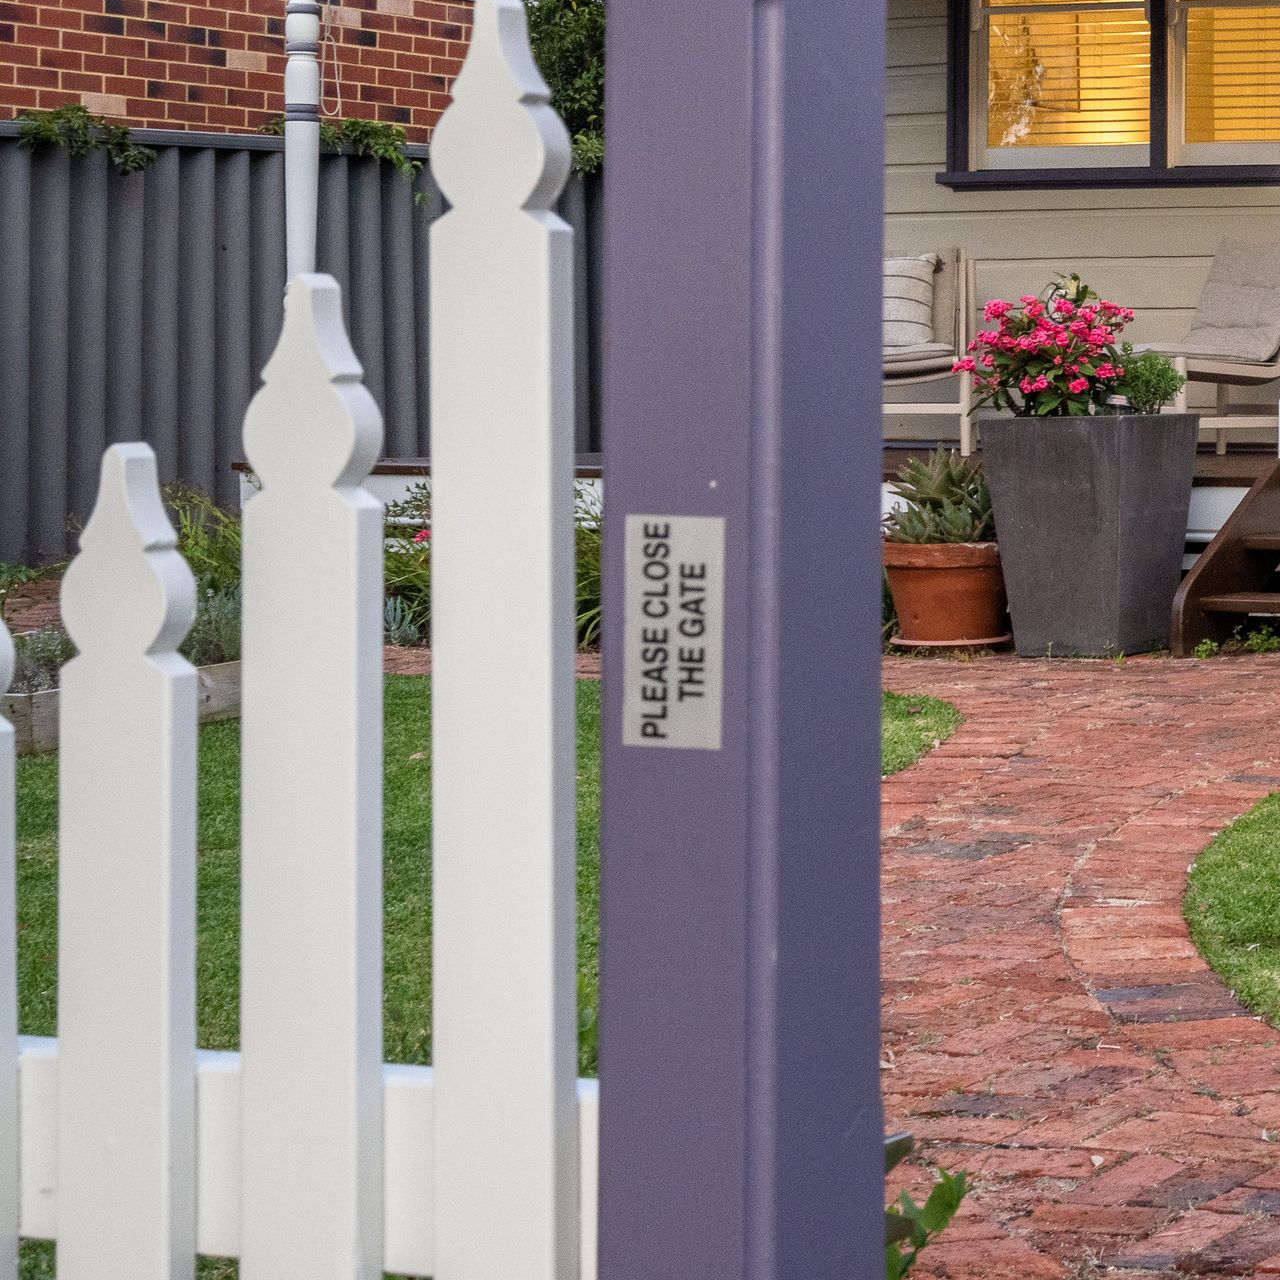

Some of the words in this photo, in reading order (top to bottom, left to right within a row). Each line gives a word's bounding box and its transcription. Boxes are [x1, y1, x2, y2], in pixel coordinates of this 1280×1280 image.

[642, 523, 671, 618] CLOSE
[677, 563, 706, 638] GATE
[641, 628, 669, 738] PLEASE
[677, 647, 706, 702] THE
